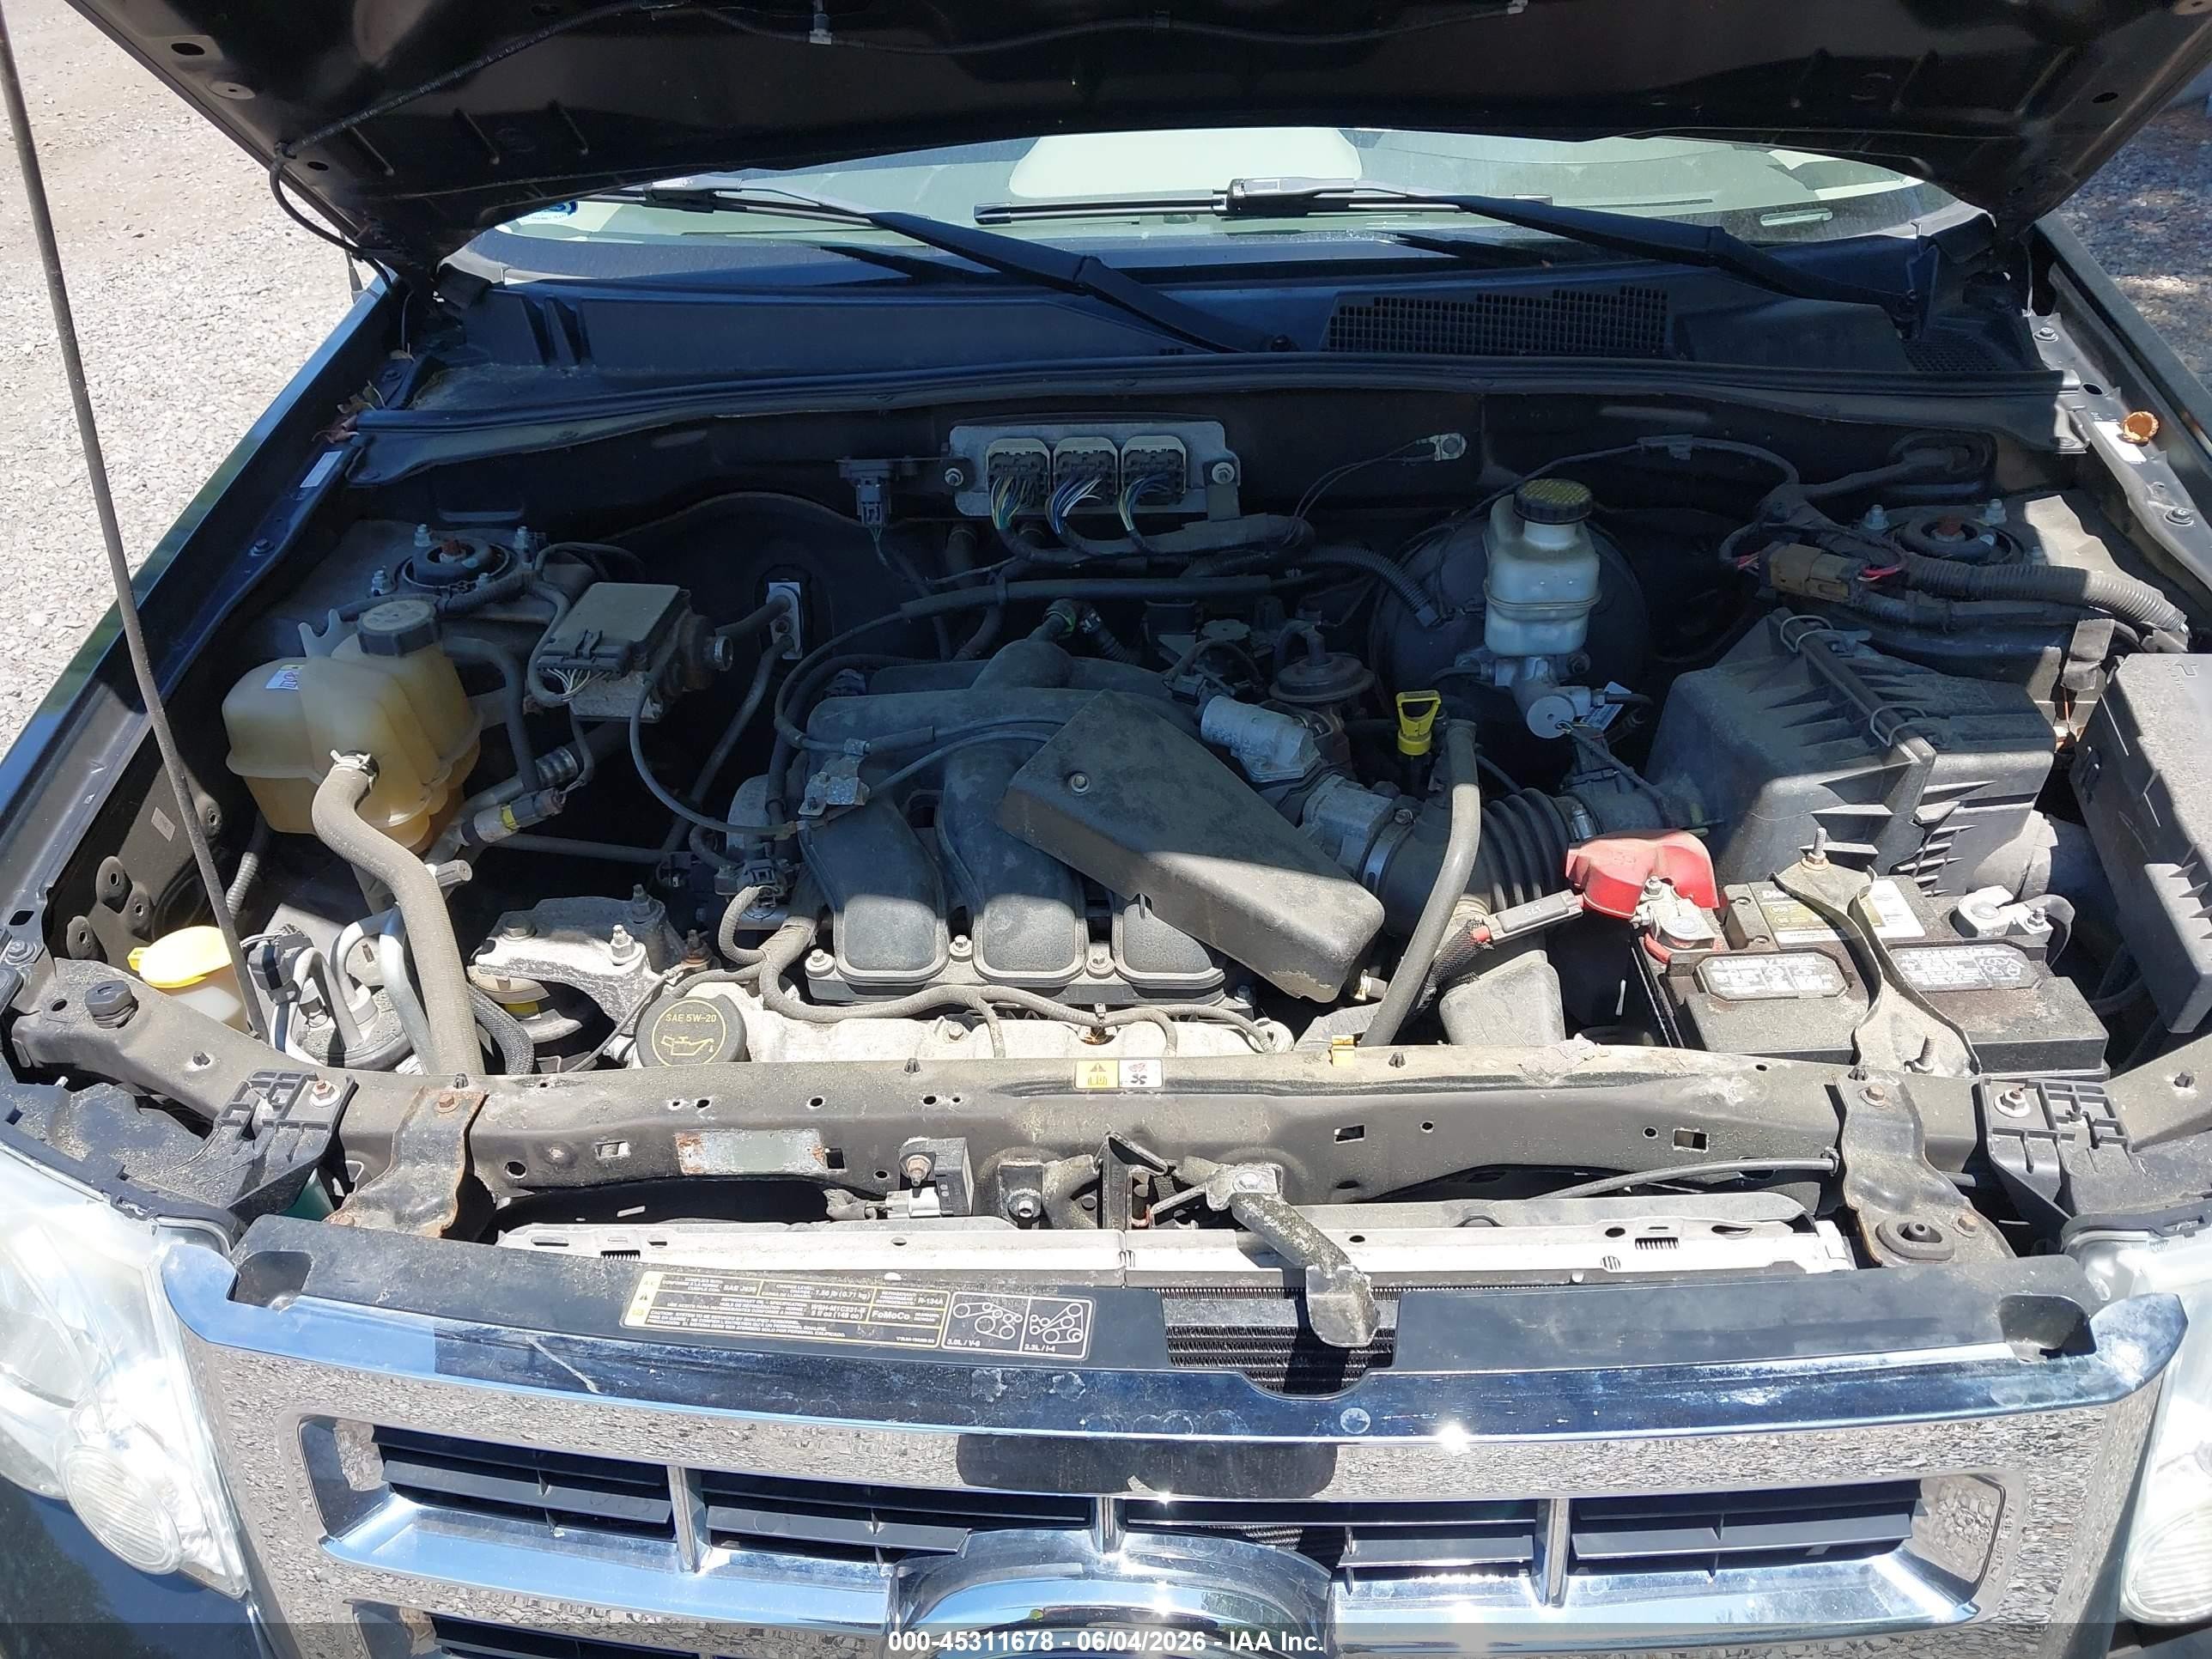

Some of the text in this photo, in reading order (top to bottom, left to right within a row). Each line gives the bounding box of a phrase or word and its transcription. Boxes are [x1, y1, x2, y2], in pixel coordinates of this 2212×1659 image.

[665, 1013, 717, 1023] SAE 5W-20
[917, 1297, 944, 1305] R-134A
[871, 1310, 911, 1320] FoMoCo
